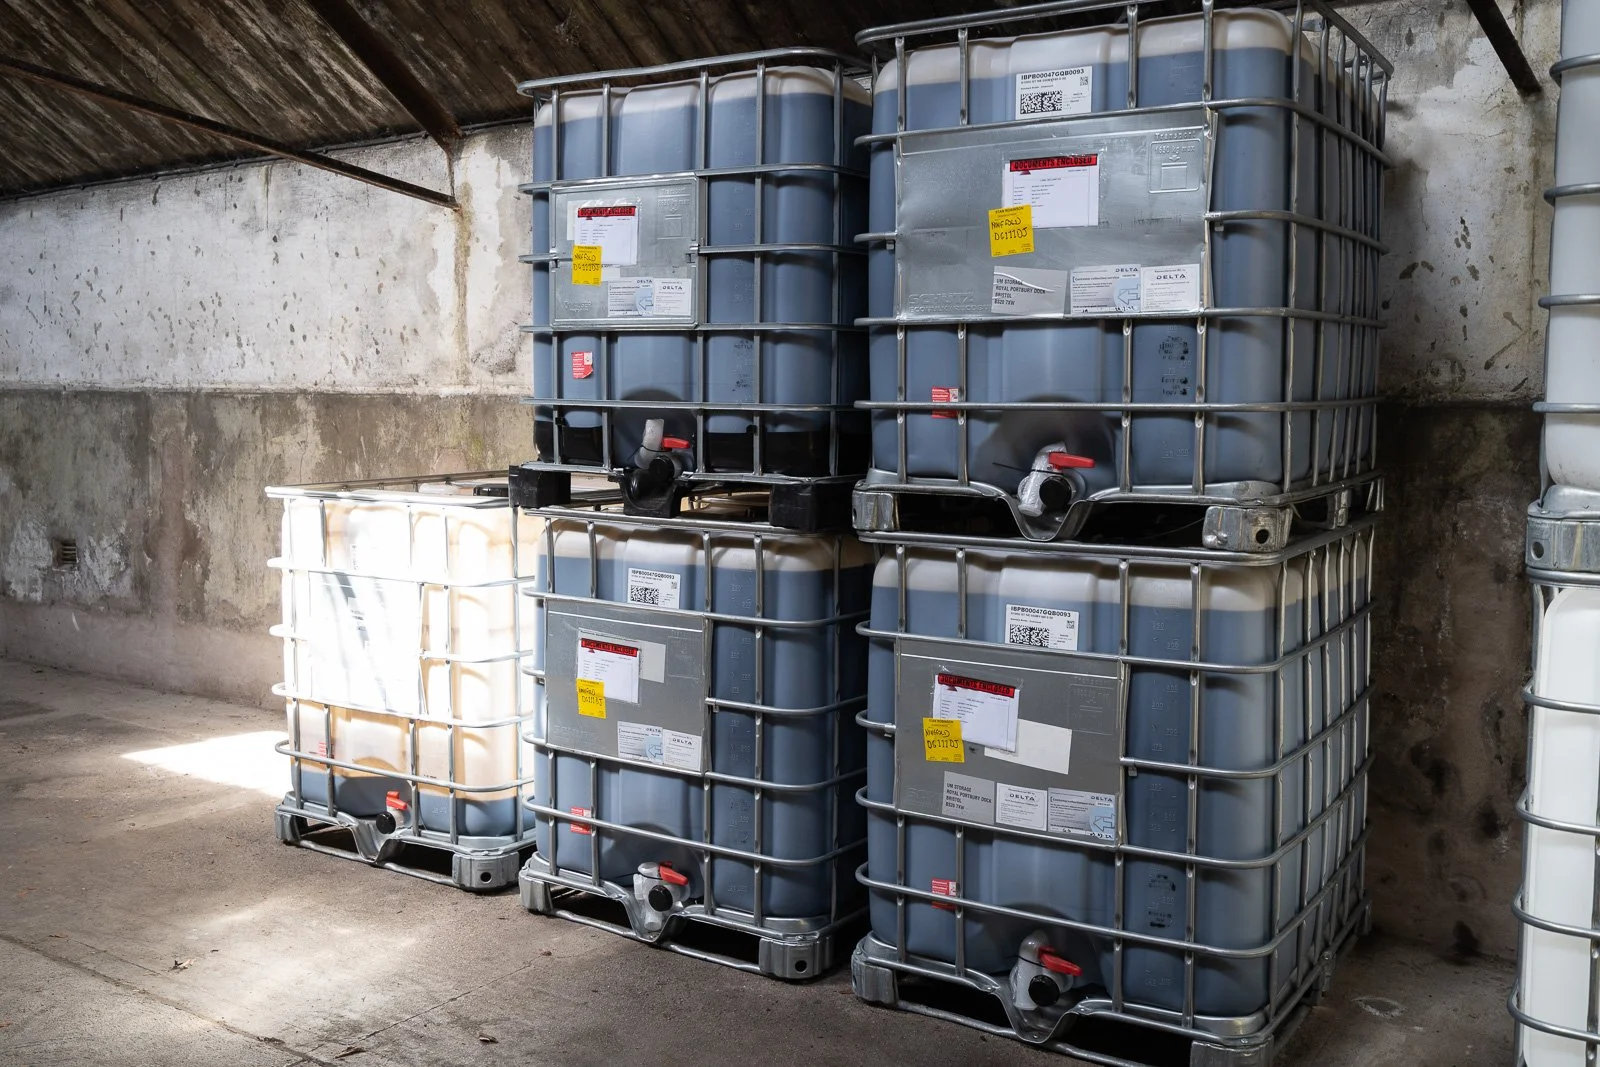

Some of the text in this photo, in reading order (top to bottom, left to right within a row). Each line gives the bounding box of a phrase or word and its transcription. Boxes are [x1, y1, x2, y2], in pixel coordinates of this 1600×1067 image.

[1021, 68, 1084, 80] IBPB00047GQB0093
[1014, 156, 1092, 170] DOCUMENTS ENCLOSED
[1010, 286, 1033, 294] PORTBURY
[1010, 606, 1071, 618] IBPB00047GQB0093
[979, 682, 1011, 695] ENCLOSED
[672, 737, 692, 745] DELTA
[954, 784, 971, 792] STORAGE
[946, 795, 962, 803] BRISTOL
[947, 789, 959, 797] ROYAL
[960, 792, 980, 801] PORTBURY
[1010, 793, 1035, 801] DELTA
